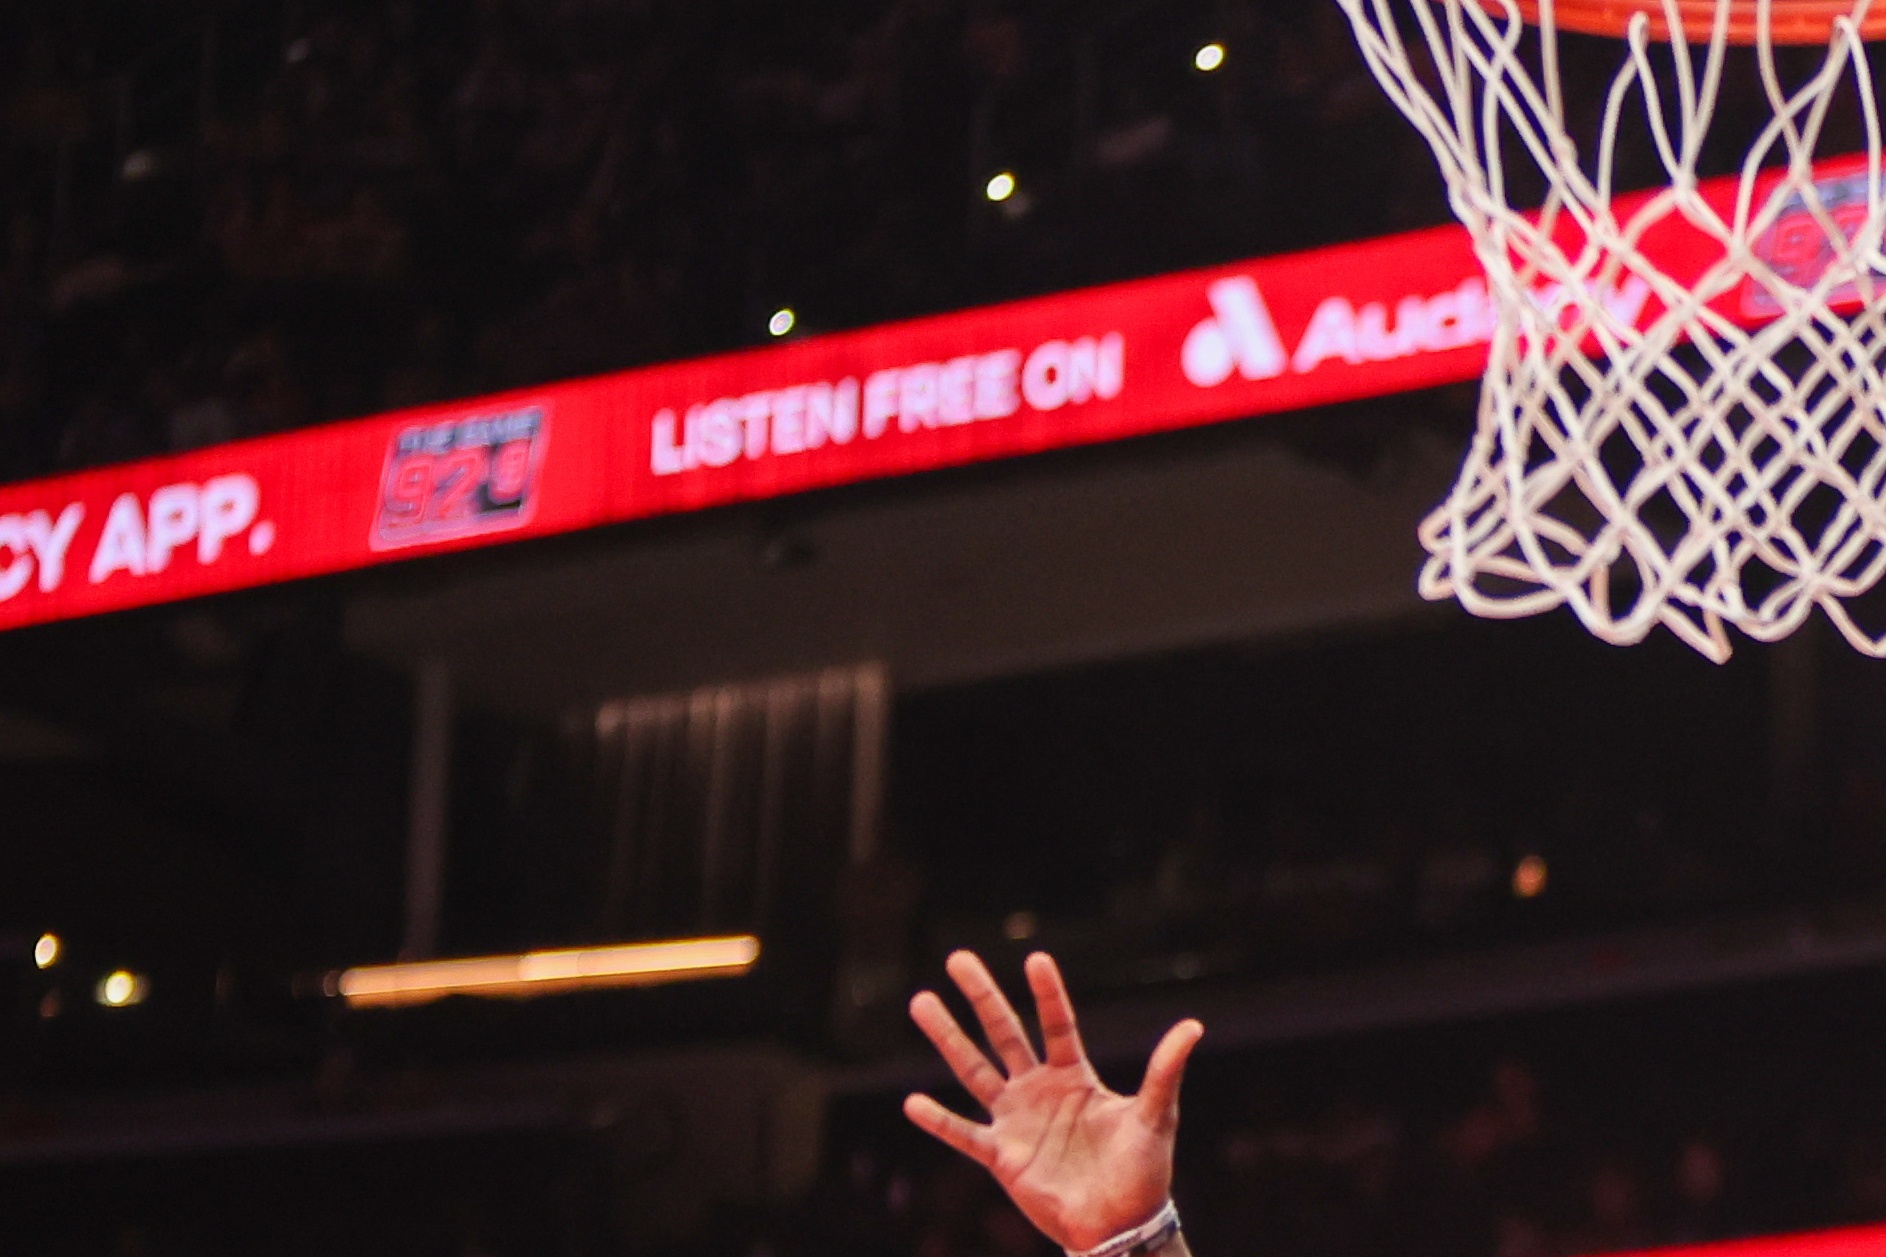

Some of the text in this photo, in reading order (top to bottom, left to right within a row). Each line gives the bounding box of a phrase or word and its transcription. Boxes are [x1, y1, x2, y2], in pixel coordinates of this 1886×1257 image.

[1293, 276, 1652, 373] Audy
[651, 376, 861, 476] LISTEN
[863, 347, 1022, 439] FREE
[1022, 331, 1126, 411] ON
[88, 473, 276, 584] APP.
